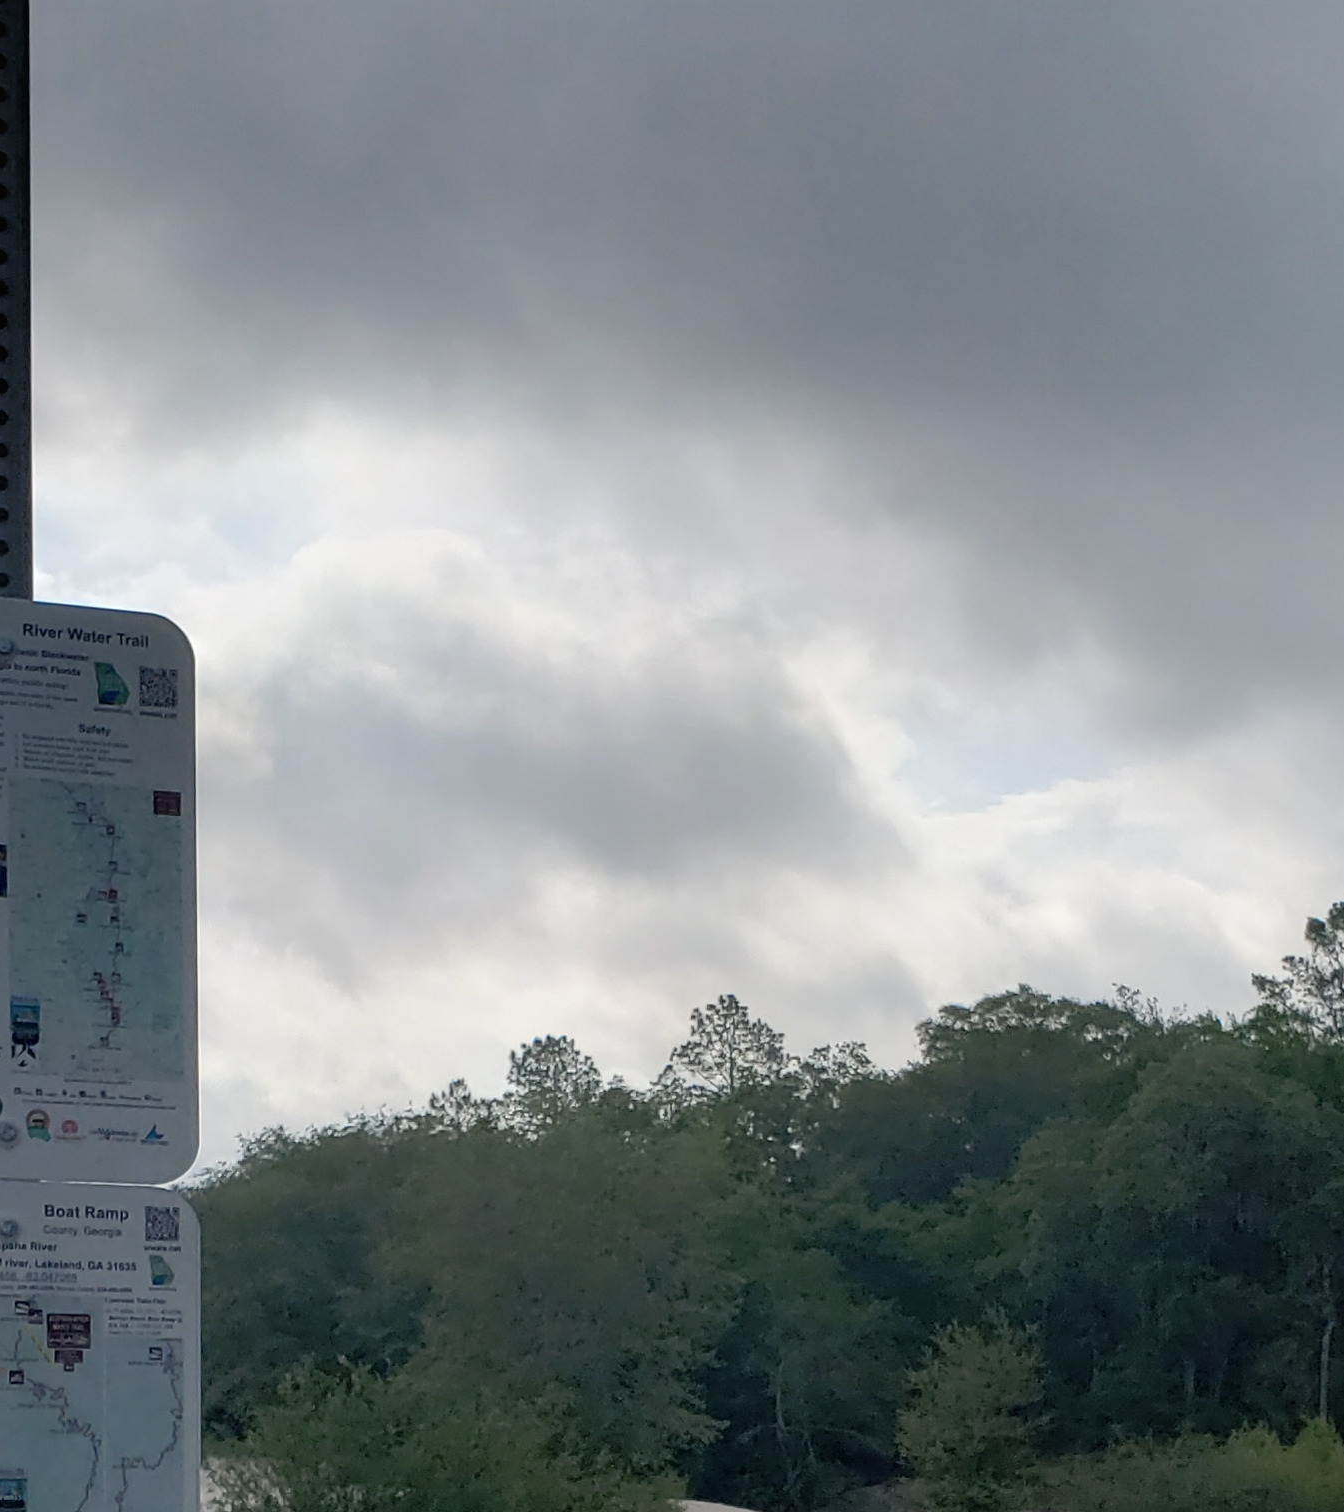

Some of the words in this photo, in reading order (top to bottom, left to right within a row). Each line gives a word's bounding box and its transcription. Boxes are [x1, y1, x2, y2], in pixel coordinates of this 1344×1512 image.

[22, 623, 64, 639] River
[67, 627, 112, 644] Water
[116, 632, 149, 648] Trail
[24, 665, 48, 673] north
[50, 666, 81, 676] Florida
[78, 723, 111, 737] Safety
[44, 1204, 80, 1219] Boat
[85, 1205, 129, 1224] Ramp
[84, 1225, 122, 1239] Georgia
[30, 1241, 57, 1251] River
[5, 1258, 32, 1269] river,
[35, 1259, 85, 1271] Lakeland,
[88, 1261, 103, 1271] GA
